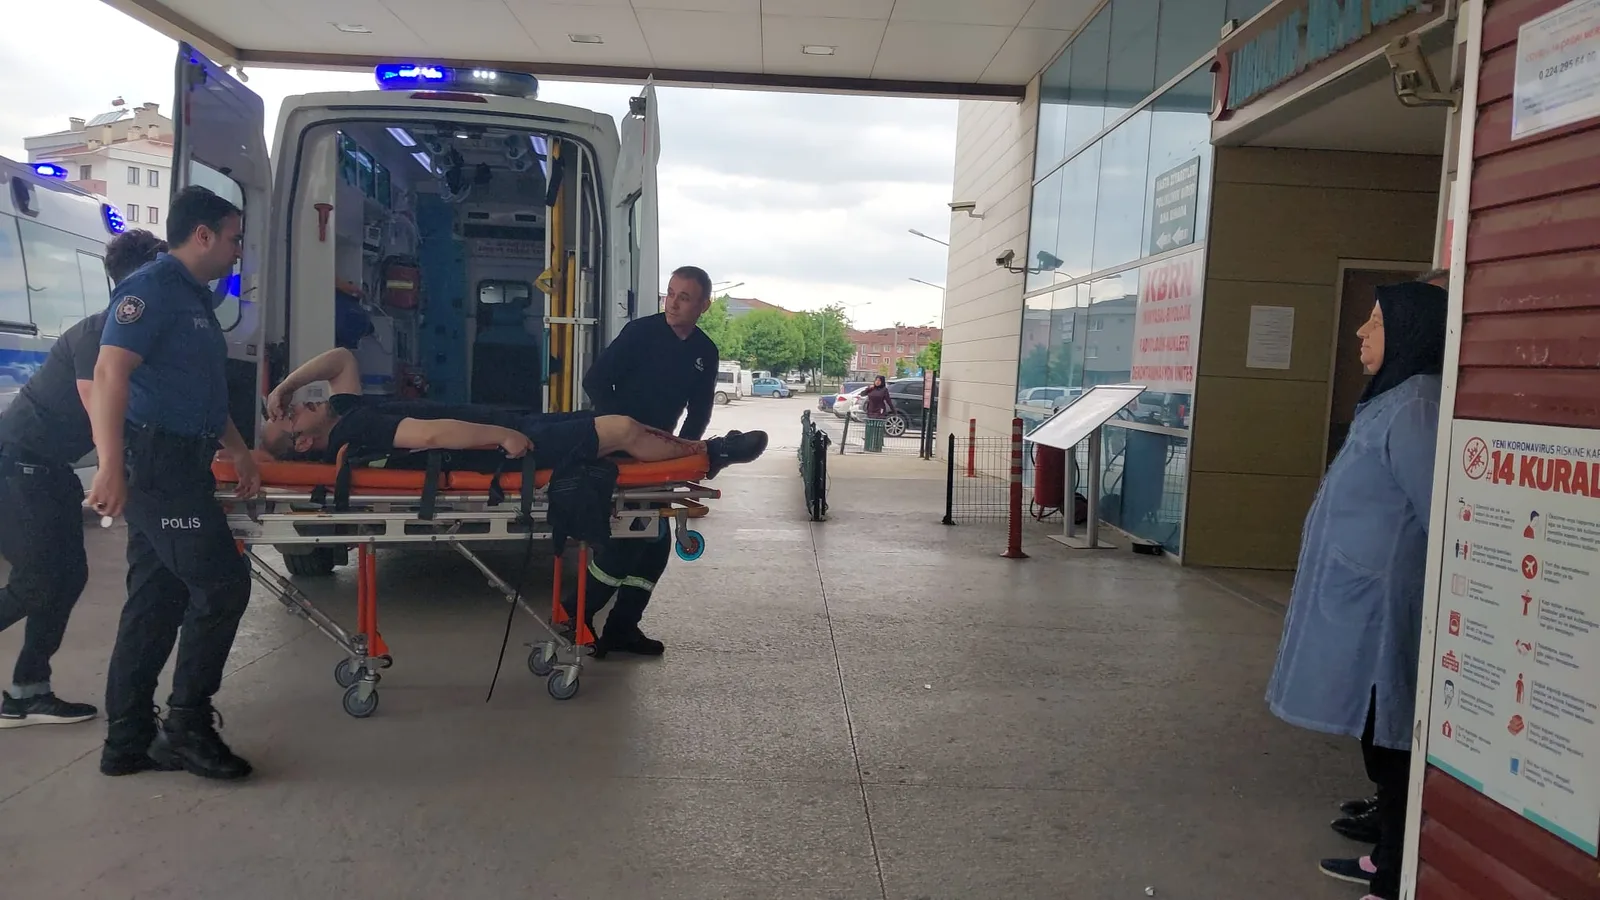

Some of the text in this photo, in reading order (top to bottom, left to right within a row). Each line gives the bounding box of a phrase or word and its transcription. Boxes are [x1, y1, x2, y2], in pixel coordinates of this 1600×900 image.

[1545, 65, 1558, 78] 224
[1145, 262, 1194, 302] KBRN
[1519, 454, 1600, 498] KURAL
